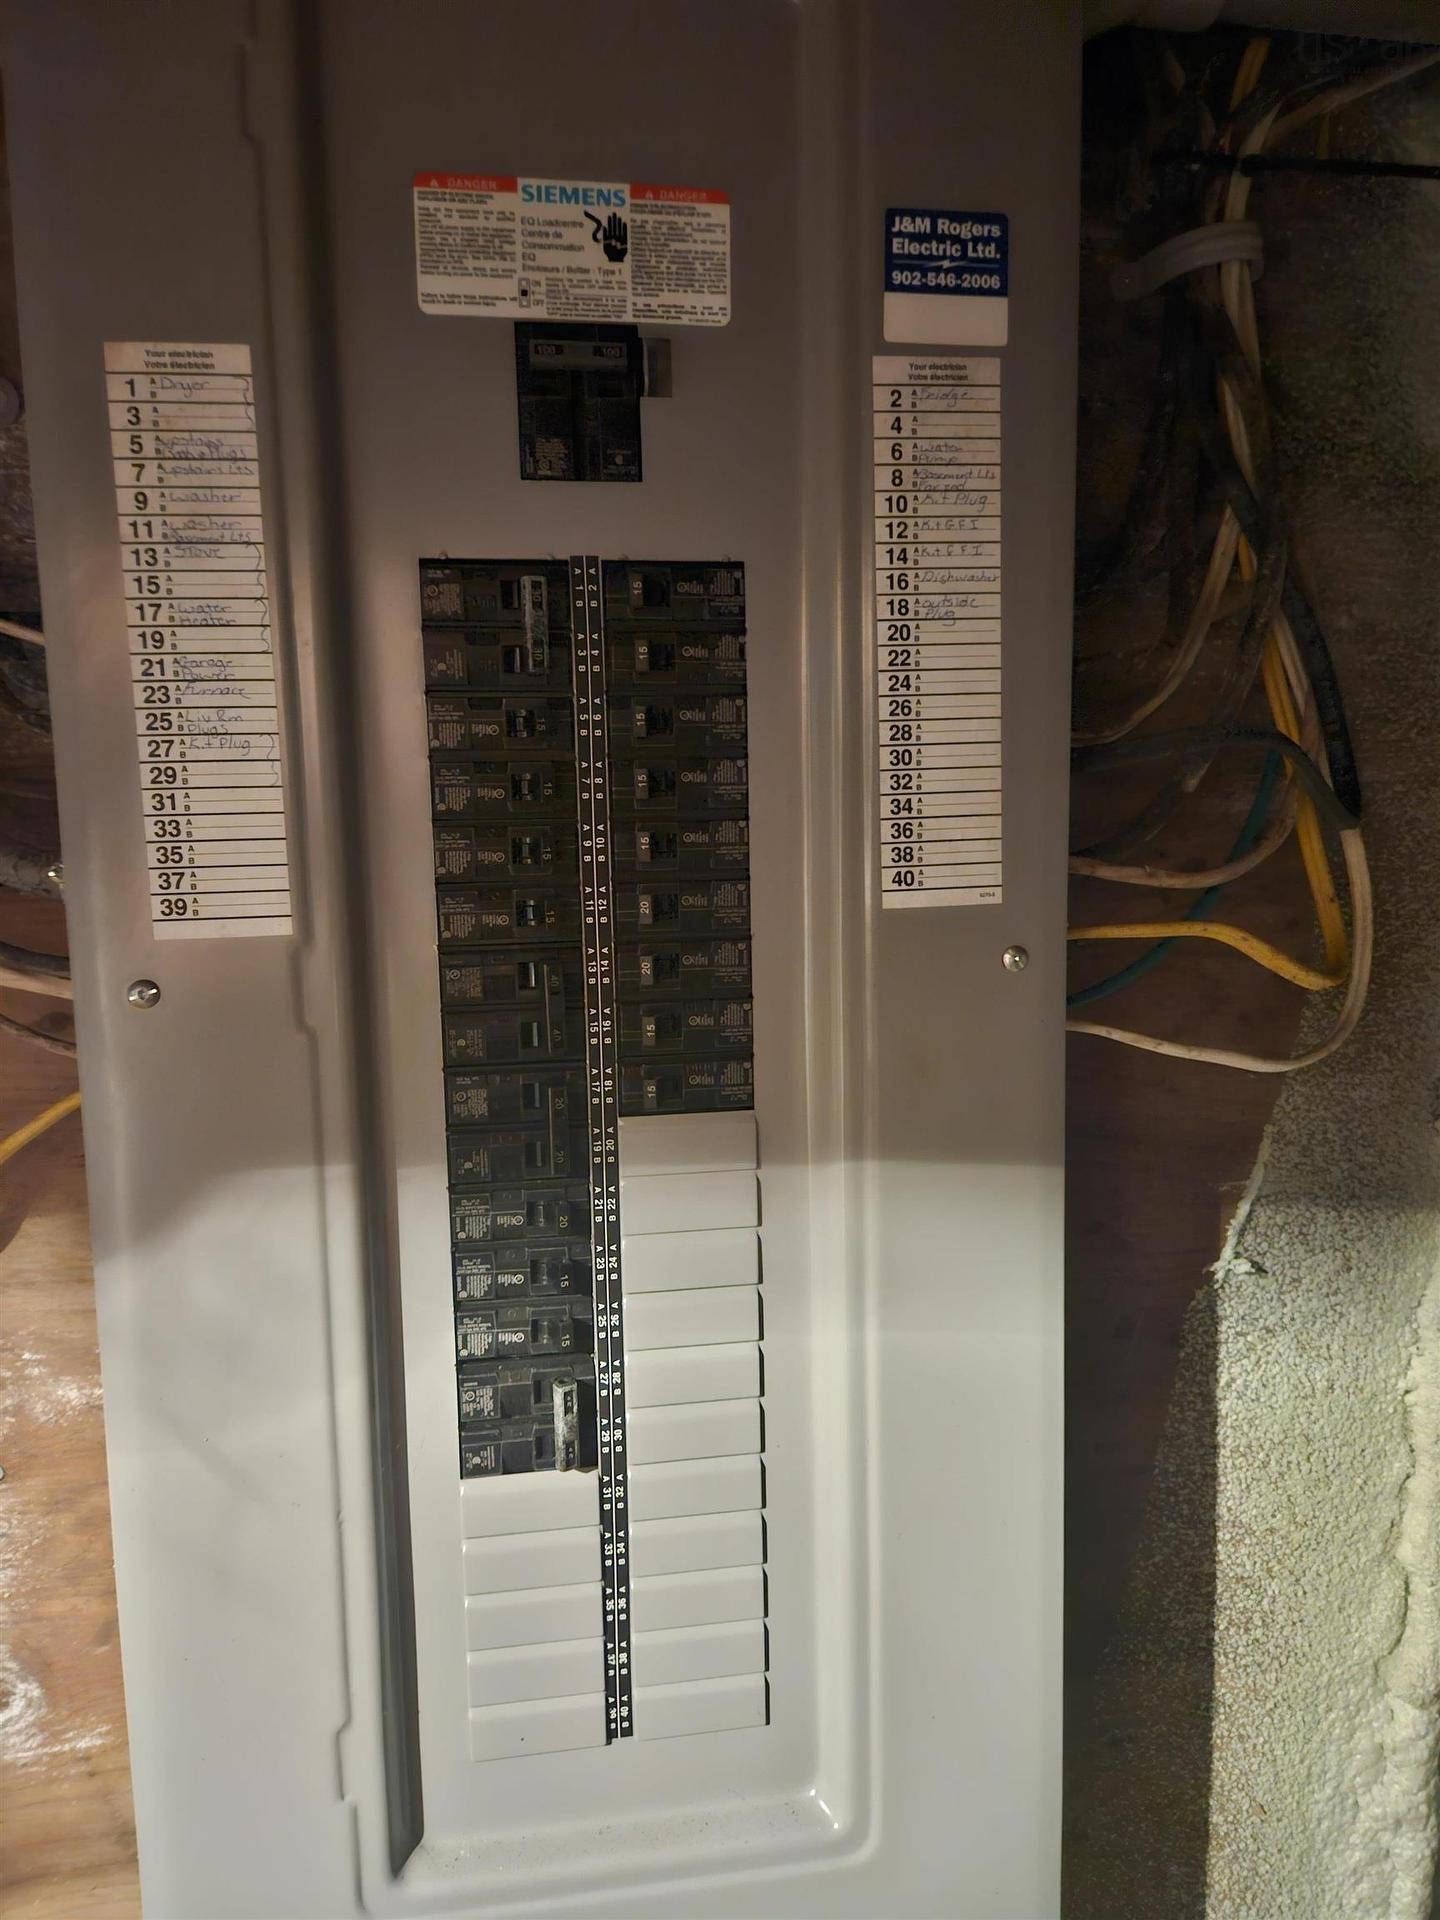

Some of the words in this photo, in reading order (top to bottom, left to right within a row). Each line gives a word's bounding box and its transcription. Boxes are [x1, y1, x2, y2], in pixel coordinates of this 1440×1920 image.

[448, 178, 496, 190] DANGER
[521, 184, 626, 207] SIEMENS
[661, 190, 707, 201] DANGER
[892, 216, 930, 233] J&M
[937, 219, 1001, 239] Rogers
[892, 238, 961, 257] Electric
[967, 241, 1001, 259] Ltd.
[892, 271, 1000, 289] 902-546-2006
[909, 363, 927, 371] Your
[928, 363, 967, 371] electrician
[125, 379, 135, 397] 1
[160, 377, 210, 398] Dryer
[891, 390, 901, 407] 2
[127, 406, 140, 426] 3
[891, 416, 902, 434] 4
[130, 435, 143, 454] 5
[892, 443, 902, 460] 6
[132, 464, 145, 482] 7
[892, 469, 903, 486] 8
[134, 492, 148, 510] 9
[885, 495, 907, 513] 10
[129, 520, 152, 538] 11
[886, 521, 908, 538] 12
[131, 548, 158, 566] 13
[886, 548, 908, 564] 14
[133, 576, 160, 594] 15
[886, 573, 908, 590] 16
[136, 603, 162, 621] 17
[887, 599, 909, 616] 18
[138, 631, 164, 649] 19
[888, 624, 910, 641] 20
[639, 646, 648, 659] 15
[888, 650, 911, 666] 22
[141, 658, 165, 676] 21
[888, 675, 911, 691] 24
[143, 686, 170, 704] 23
[889, 700, 912, 716] 26
[146, 712, 172, 730] 25
[636, 712, 645, 726] 15
[890, 724, 912, 741] 28
[148, 740, 174, 757] 27
[890, 749, 912, 766] 30
[150, 766, 176, 784] 29
[638, 774, 647, 788] 15
[890, 774, 912, 790] 32
[152, 793, 176, 811] 31
[890, 798, 913, 815] 34
[154, 820, 181, 838] 33
[891, 822, 913, 839] 36
[641, 833, 650, 849] 15
[156, 846, 183, 864] 35
[892, 846, 914, 863] 38
[158, 872, 185, 890] 37
[892, 870, 914, 886] 40
[160, 898, 187, 916] 39
[639, 901, 649, 914] 20
[641, 962, 651, 975] 20
[647, 1024, 656, 1037] 15
[647, 1085, 656, 1098] 15
[593, 1141, 602, 1151] 19
[606, 1139, 614, 1150] 20
[595, 1199, 603, 1209] 21
[607, 1198, 616, 1209] 22
[559, 1216, 568, 1228] 20
[596, 1257, 605, 1268] 23
[609, 1257, 617, 1268] 24
[561, 1274, 570, 1288] 15
[598, 1315, 607, 1327] 25
[611, 1314, 619, 1326] 26
[562, 1334, 571, 1347] 15
[600, 1373, 608, 1385] 27
[612, 1372, 621, 1384] 28
[602, 1430, 610, 1442] 29
[614, 1429, 622, 1441] 30
[603, 1487, 611, 1498] 31
[616, 1486, 624, 1497] 32
[617, 1543, 625, 1554] 34
[618, 1598, 626, 1609] 36
[619, 1653, 627, 1664] 38
[621, 1706, 628, 1717] 40
